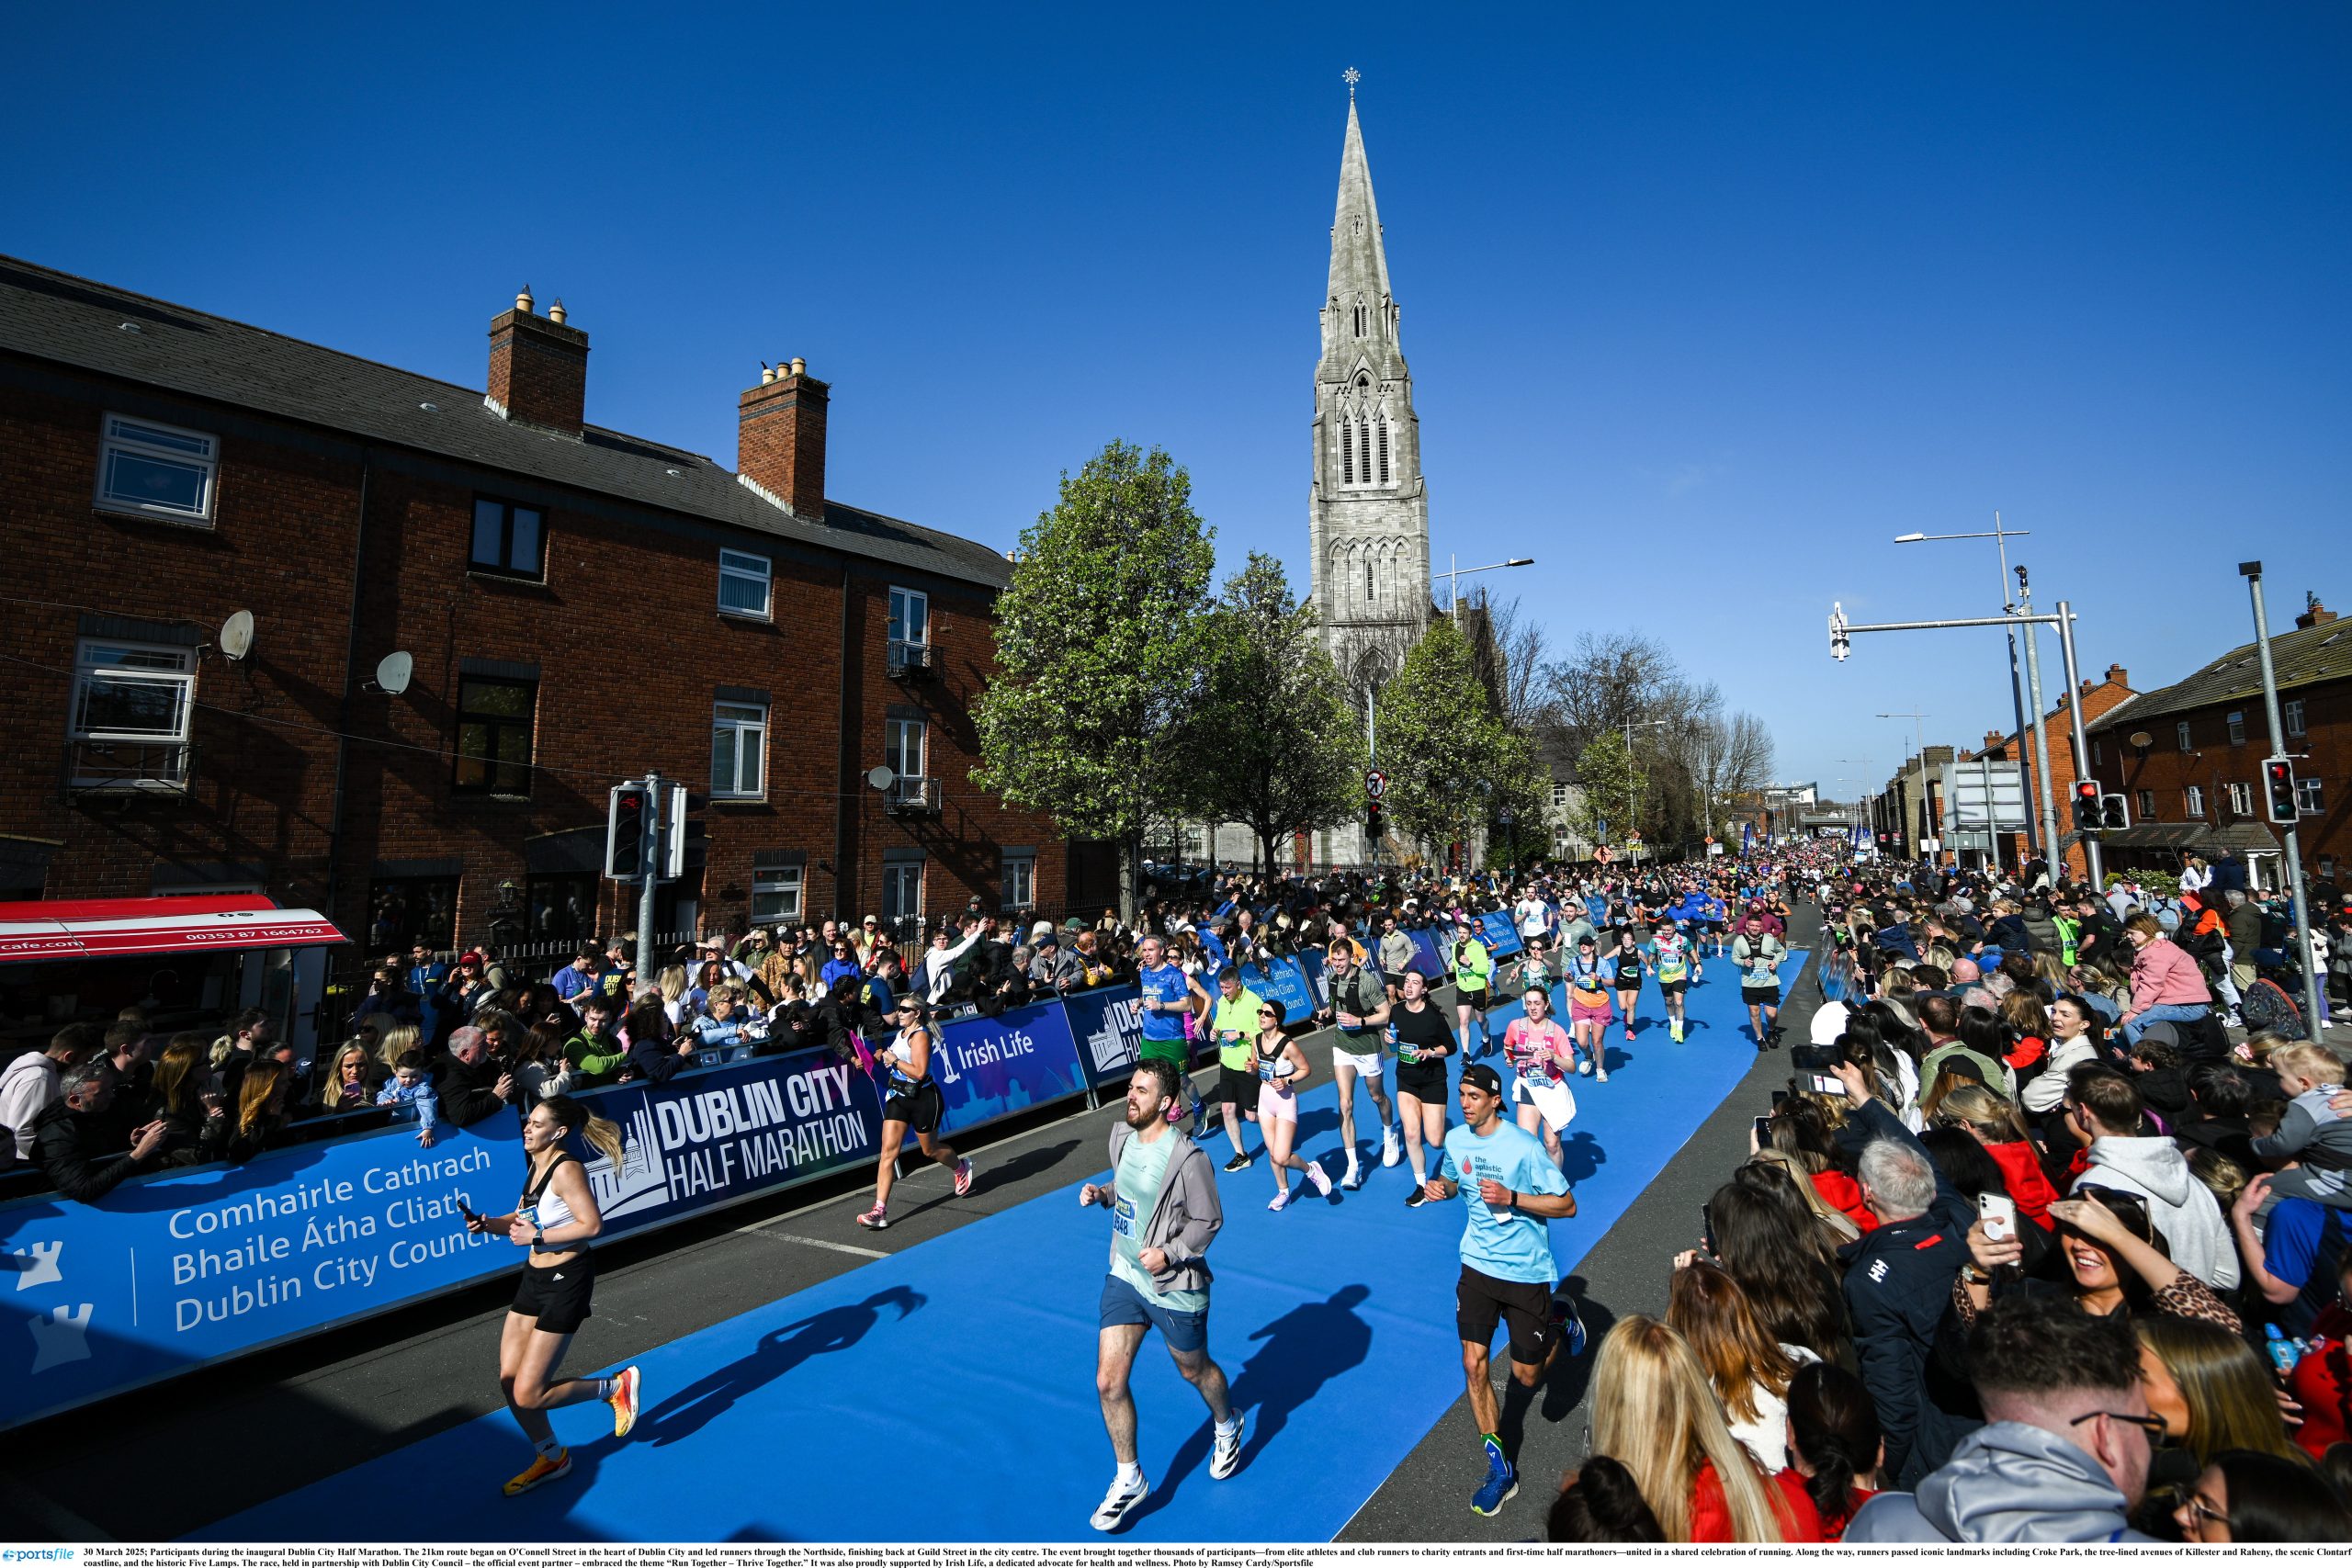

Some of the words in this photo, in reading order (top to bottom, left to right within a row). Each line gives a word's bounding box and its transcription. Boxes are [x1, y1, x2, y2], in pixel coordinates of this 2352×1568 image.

[1, 941, 85, 950] cafe.com
[187, 932, 235, 941] 00353
[261, 928, 323, 937] 1664762
[956, 1038, 1001, 1070] Irish
[1000, 1030, 1035, 1059] Life
[656, 1078, 786, 1151] DUBLIN
[786, 1064, 852, 1118] CITY
[666, 1142, 736, 1201] HALF
[740, 1110, 868, 1180] MARATHON
[1475, 1156, 1487, 1164] the
[1475, 1164, 1502, 1173] aplastic
[169, 1179, 354, 1240] Comhairle
[363, 1145, 492, 1195] Cathrach
[1476, 1171, 1504, 1181] anaemia
[173, 1235, 290, 1286] Bhaile
[301, 1215, 377, 1253] Átha
[386, 1187, 472, 1229] Cliath
[175, 1275, 302, 1332] Dublin
[313, 1255, 379, 1288] City
